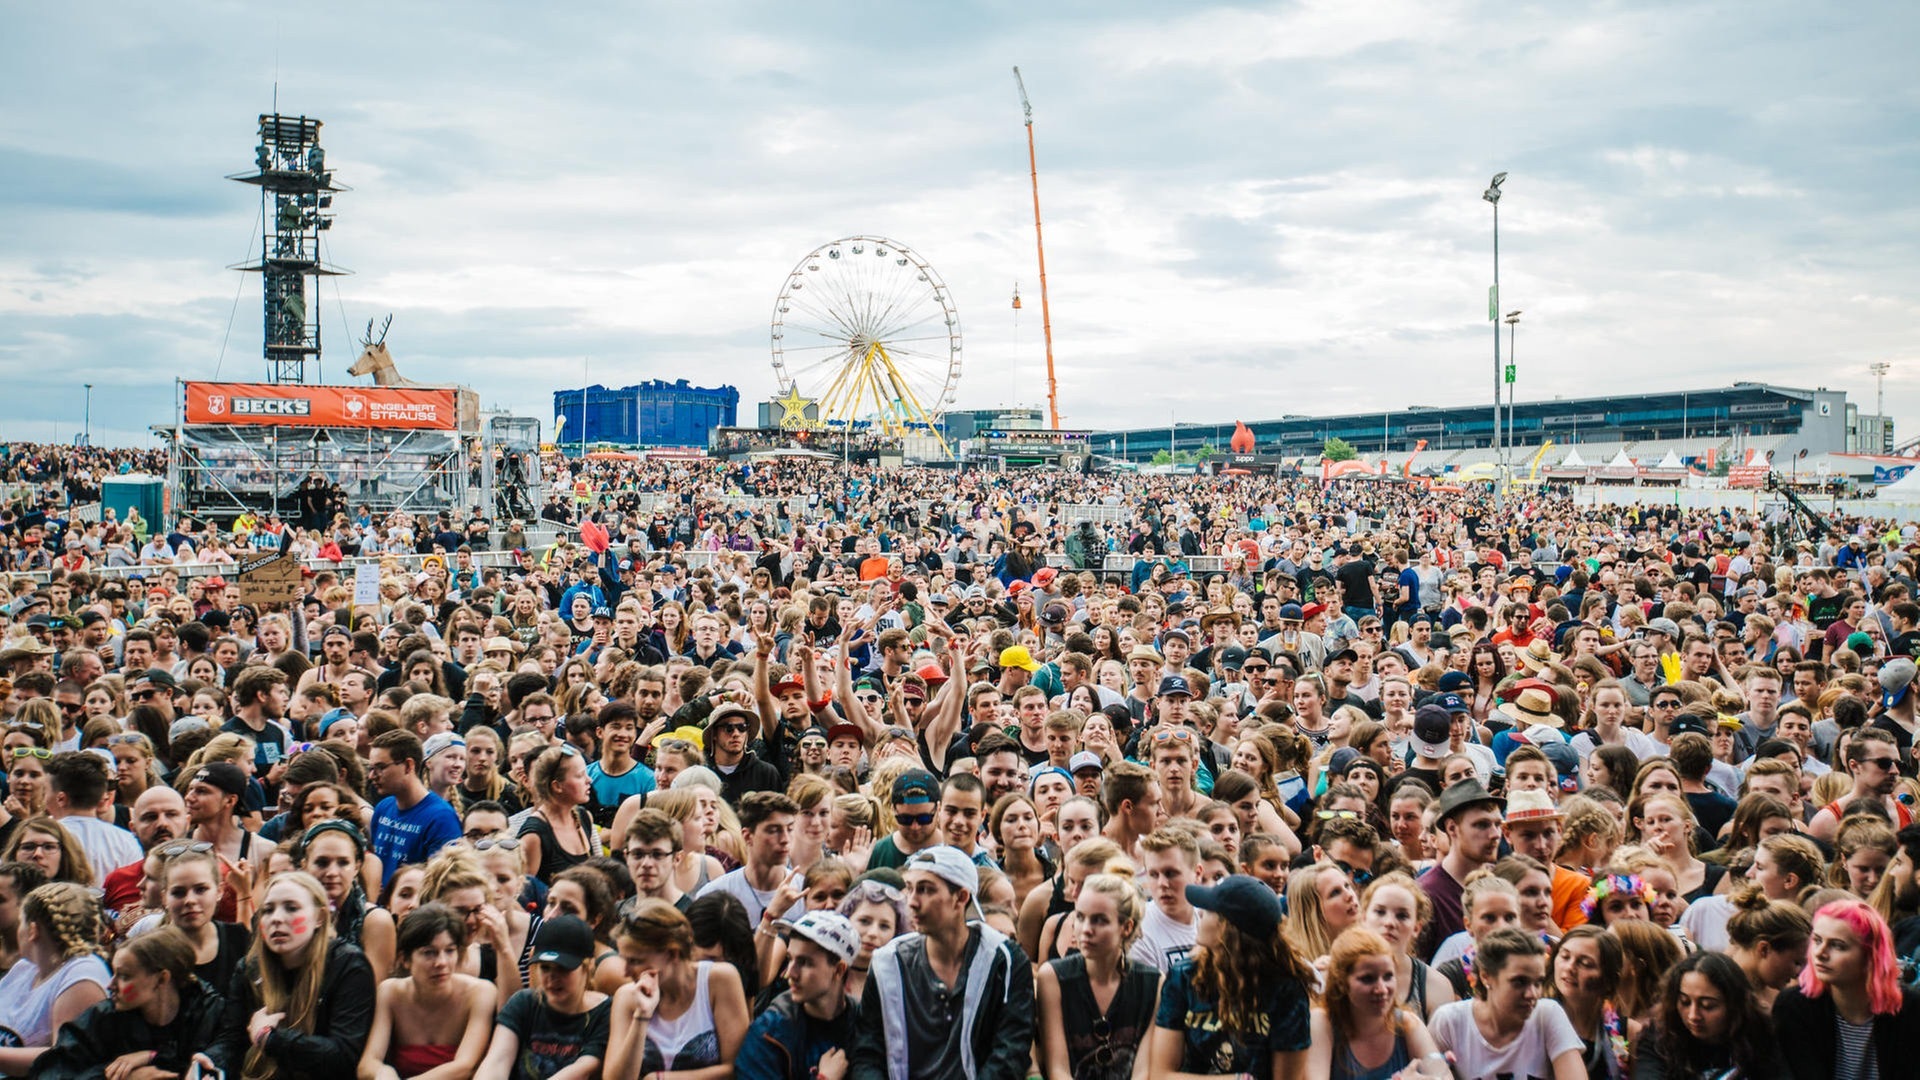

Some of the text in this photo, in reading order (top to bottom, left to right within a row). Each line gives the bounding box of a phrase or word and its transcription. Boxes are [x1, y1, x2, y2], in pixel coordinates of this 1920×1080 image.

[233, 399, 308, 415] BECK'S
[370, 402, 436, 412] ENGELBERT
[370, 411, 437, 421] STRAUSS
[247, 552, 281, 571] DASDING
[1184, 1009, 1271, 1037] ATLNIS
